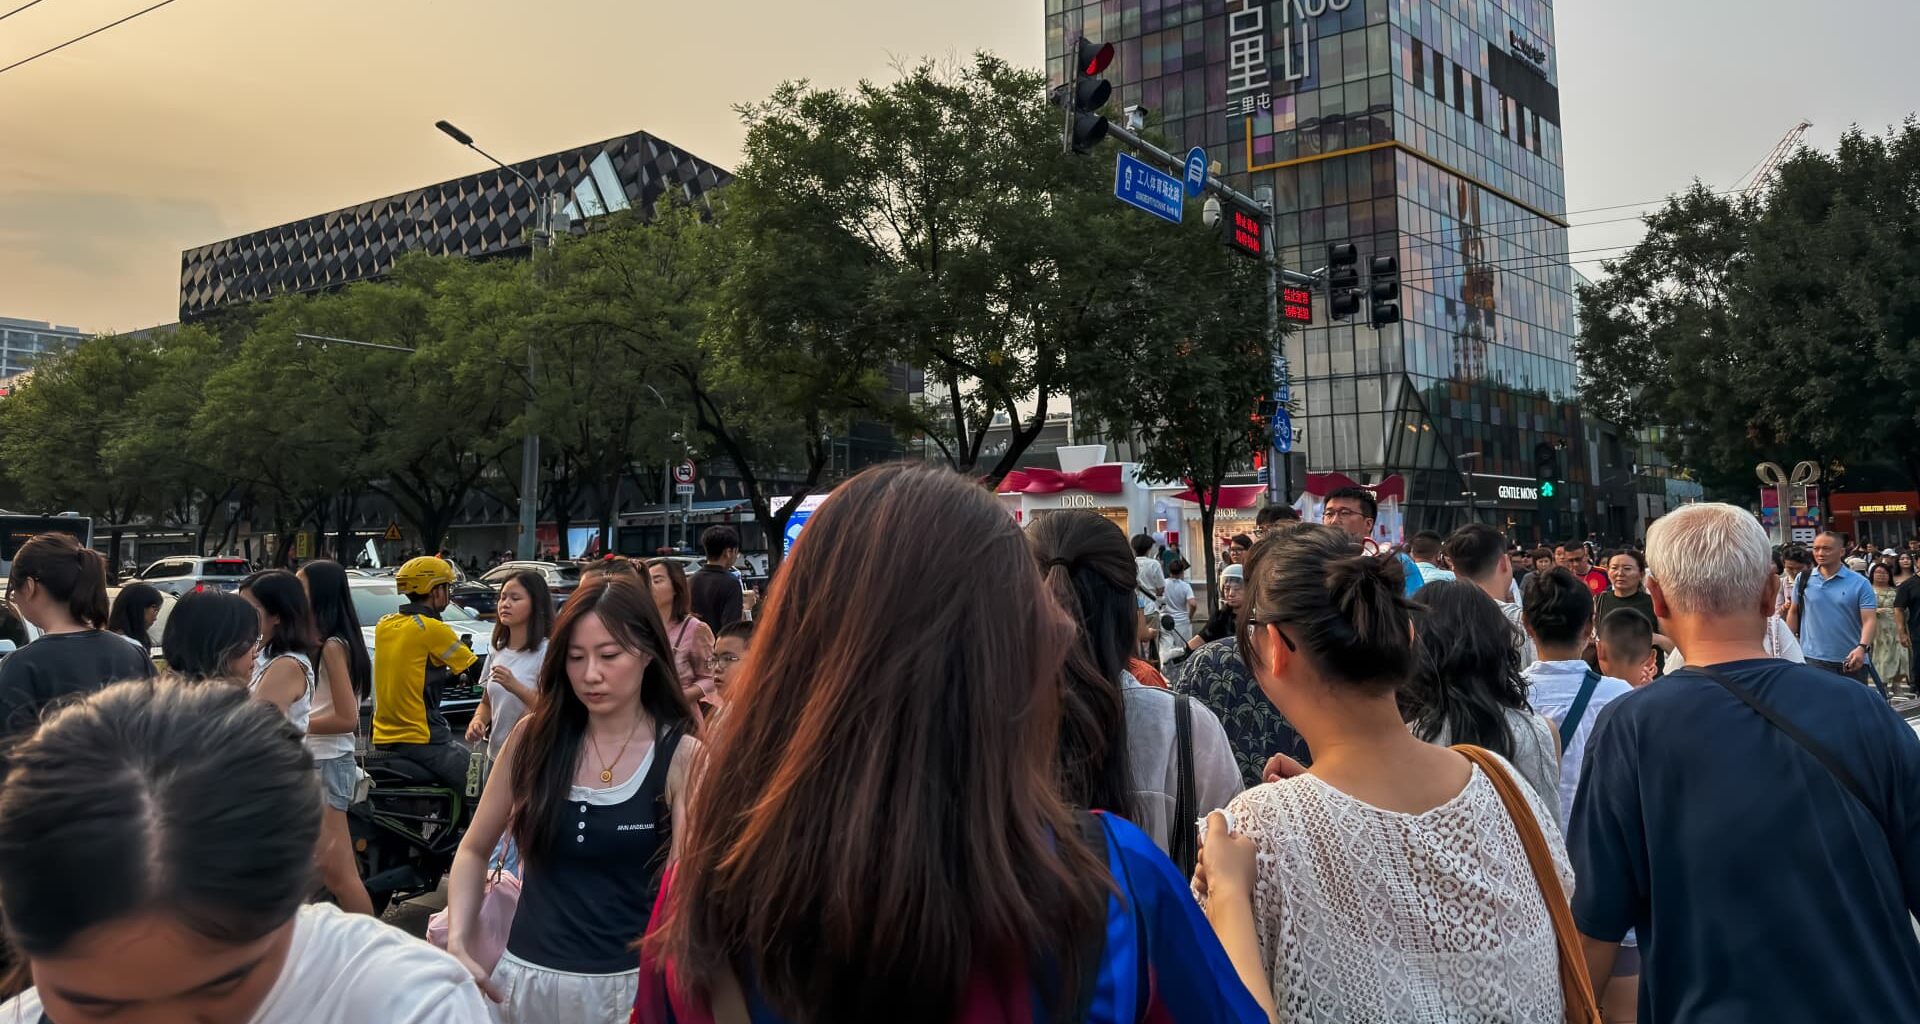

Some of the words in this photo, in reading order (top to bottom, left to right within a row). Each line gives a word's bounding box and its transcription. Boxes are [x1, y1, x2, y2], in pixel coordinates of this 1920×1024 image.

[1225, 92, 1271, 118] 三里屯
[1498, 485, 1520, 499] GENTLE
[1062, 494, 1095, 508] DIOR
